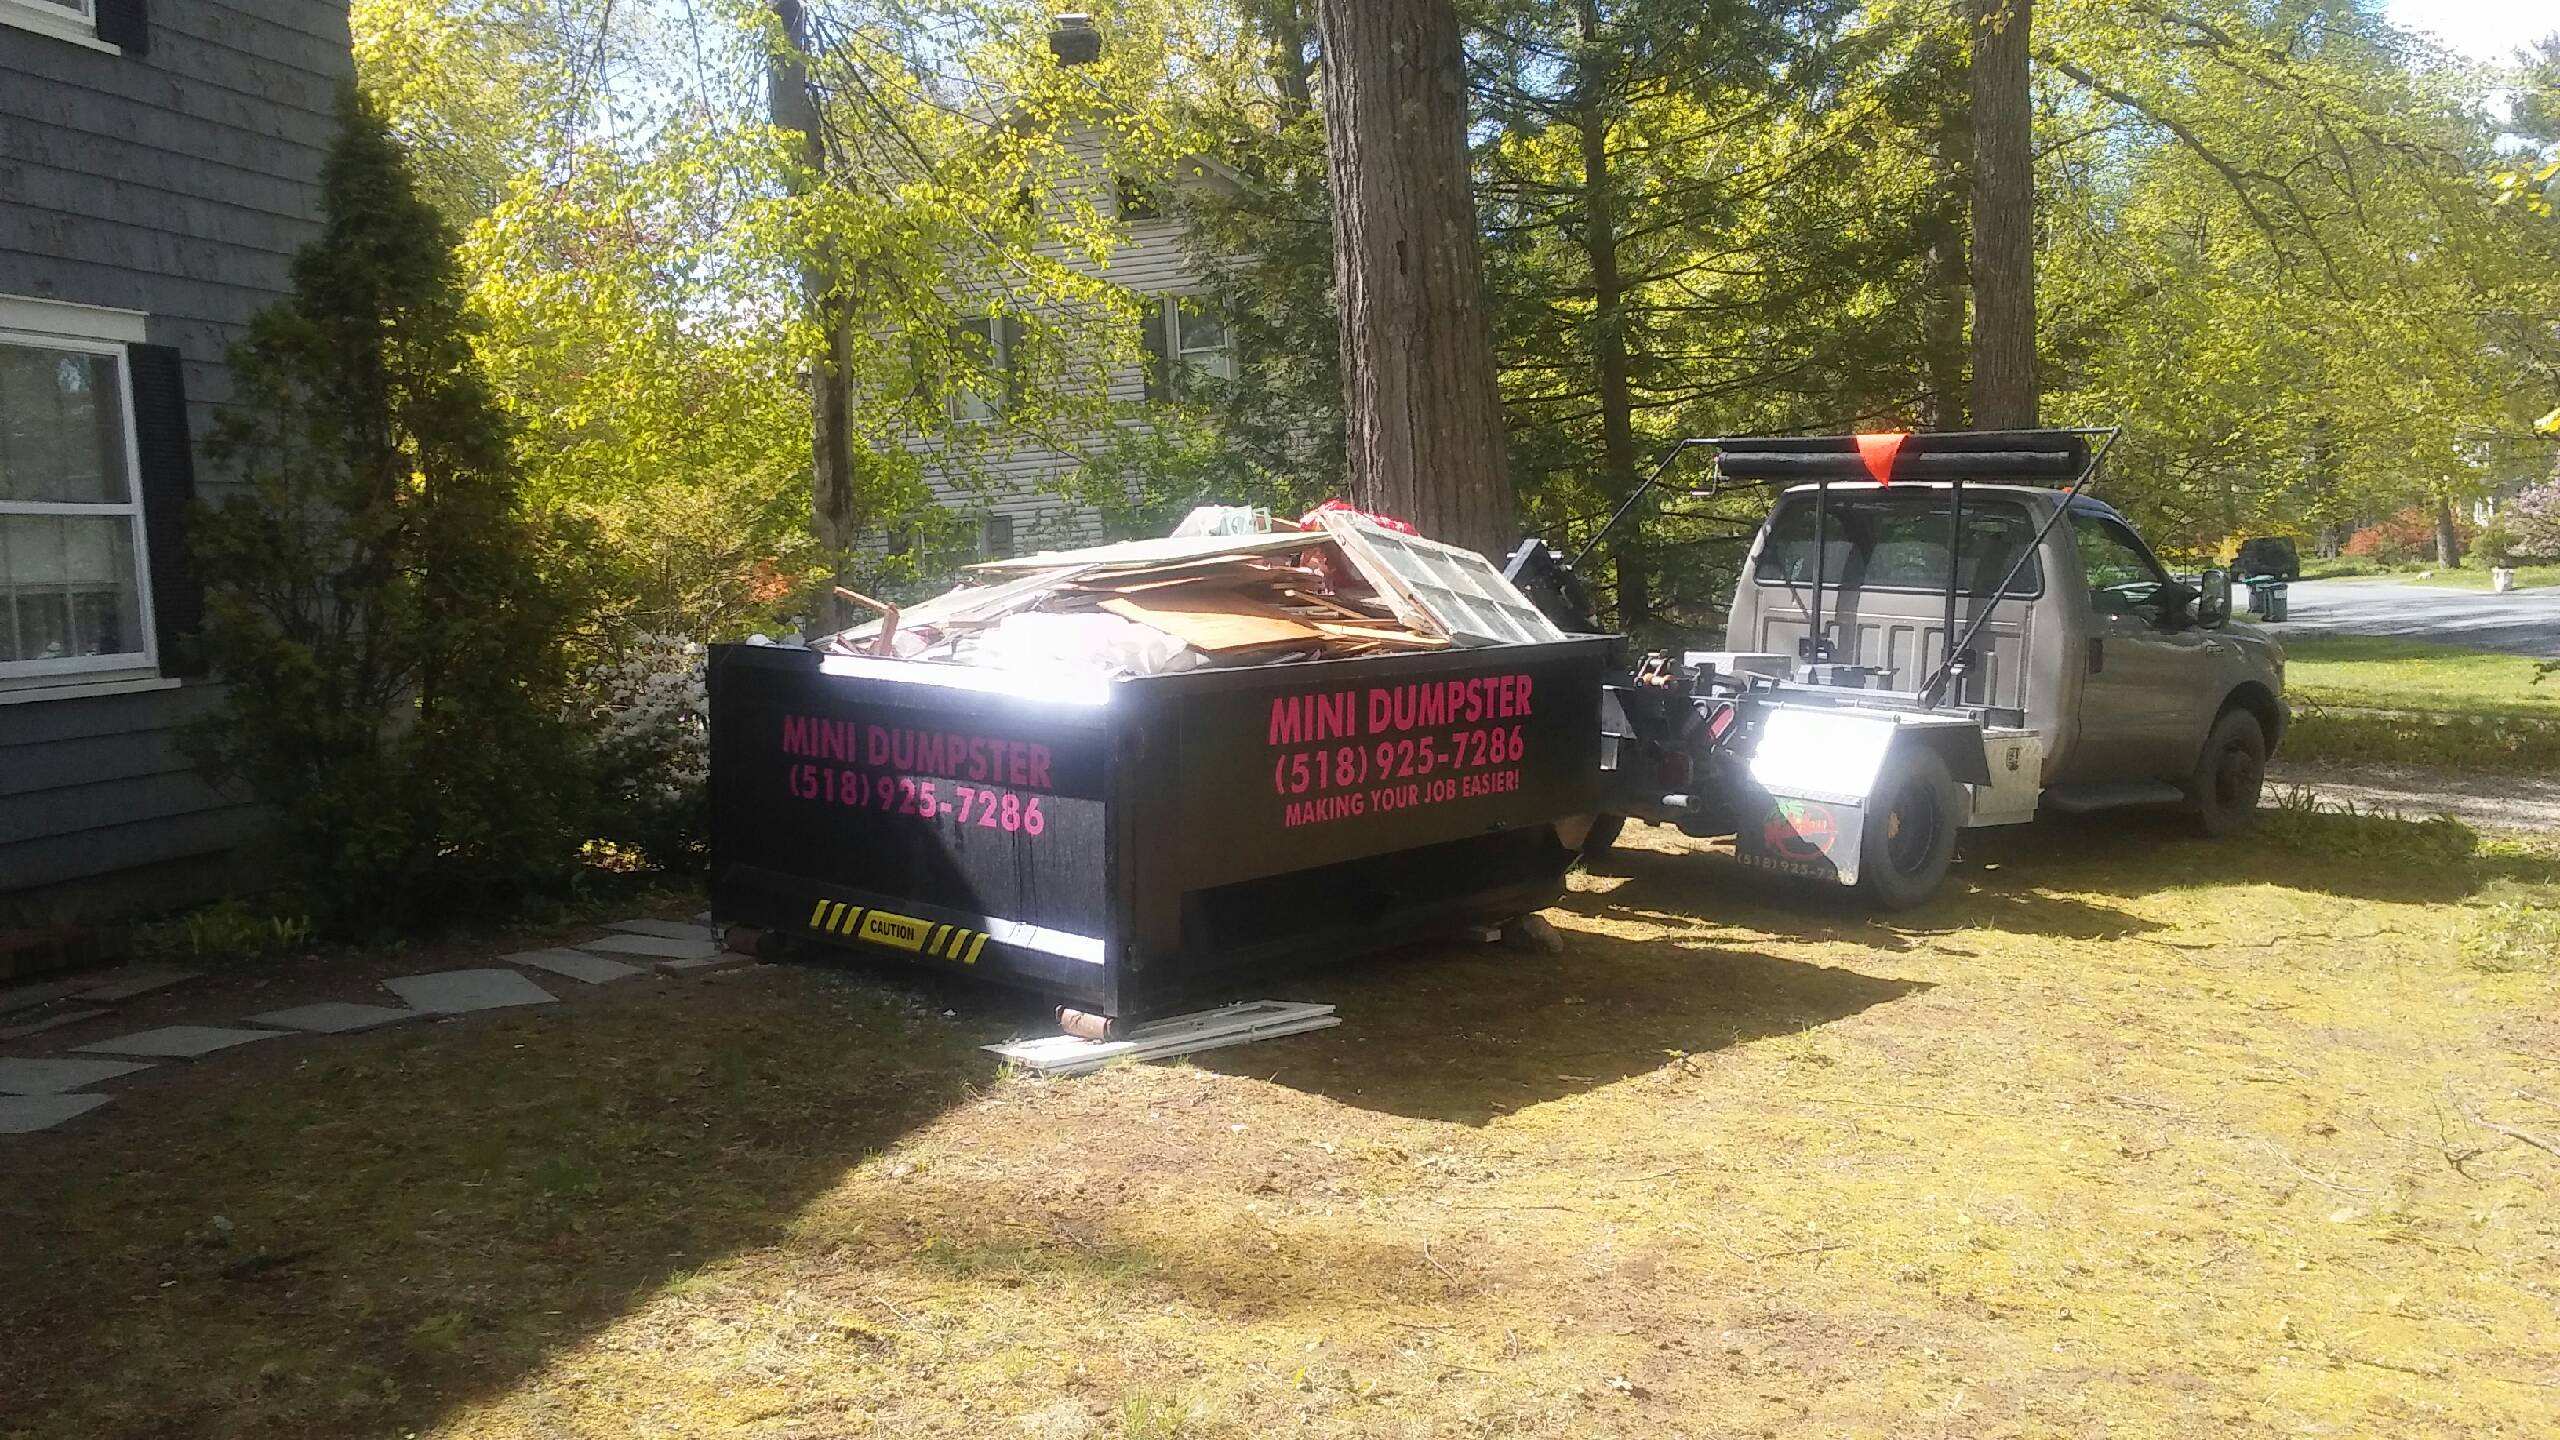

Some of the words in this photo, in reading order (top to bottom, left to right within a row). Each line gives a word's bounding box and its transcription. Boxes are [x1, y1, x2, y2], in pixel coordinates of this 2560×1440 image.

[1269, 691, 1356, 745] MINI
[1368, 674, 1533, 734] DUMPSTER
[783, 714, 856, 762] MINI
[868, 725, 1052, 788] DUMPSTER
[1275, 746, 1367, 795] (518)
[1376, 725, 1525, 780] 925-7286
[790, 764, 870, 808] (518)
[877, 774, 1045, 836] 925-7286
[1285, 792, 1365, 828] MAKING
[1371, 784, 1418, 812] YOUR
[1424, 778, 1456, 803] JOB
[1463, 769, 1520, 798] EASIER!
[870, 918, 915, 941] CAUTION
